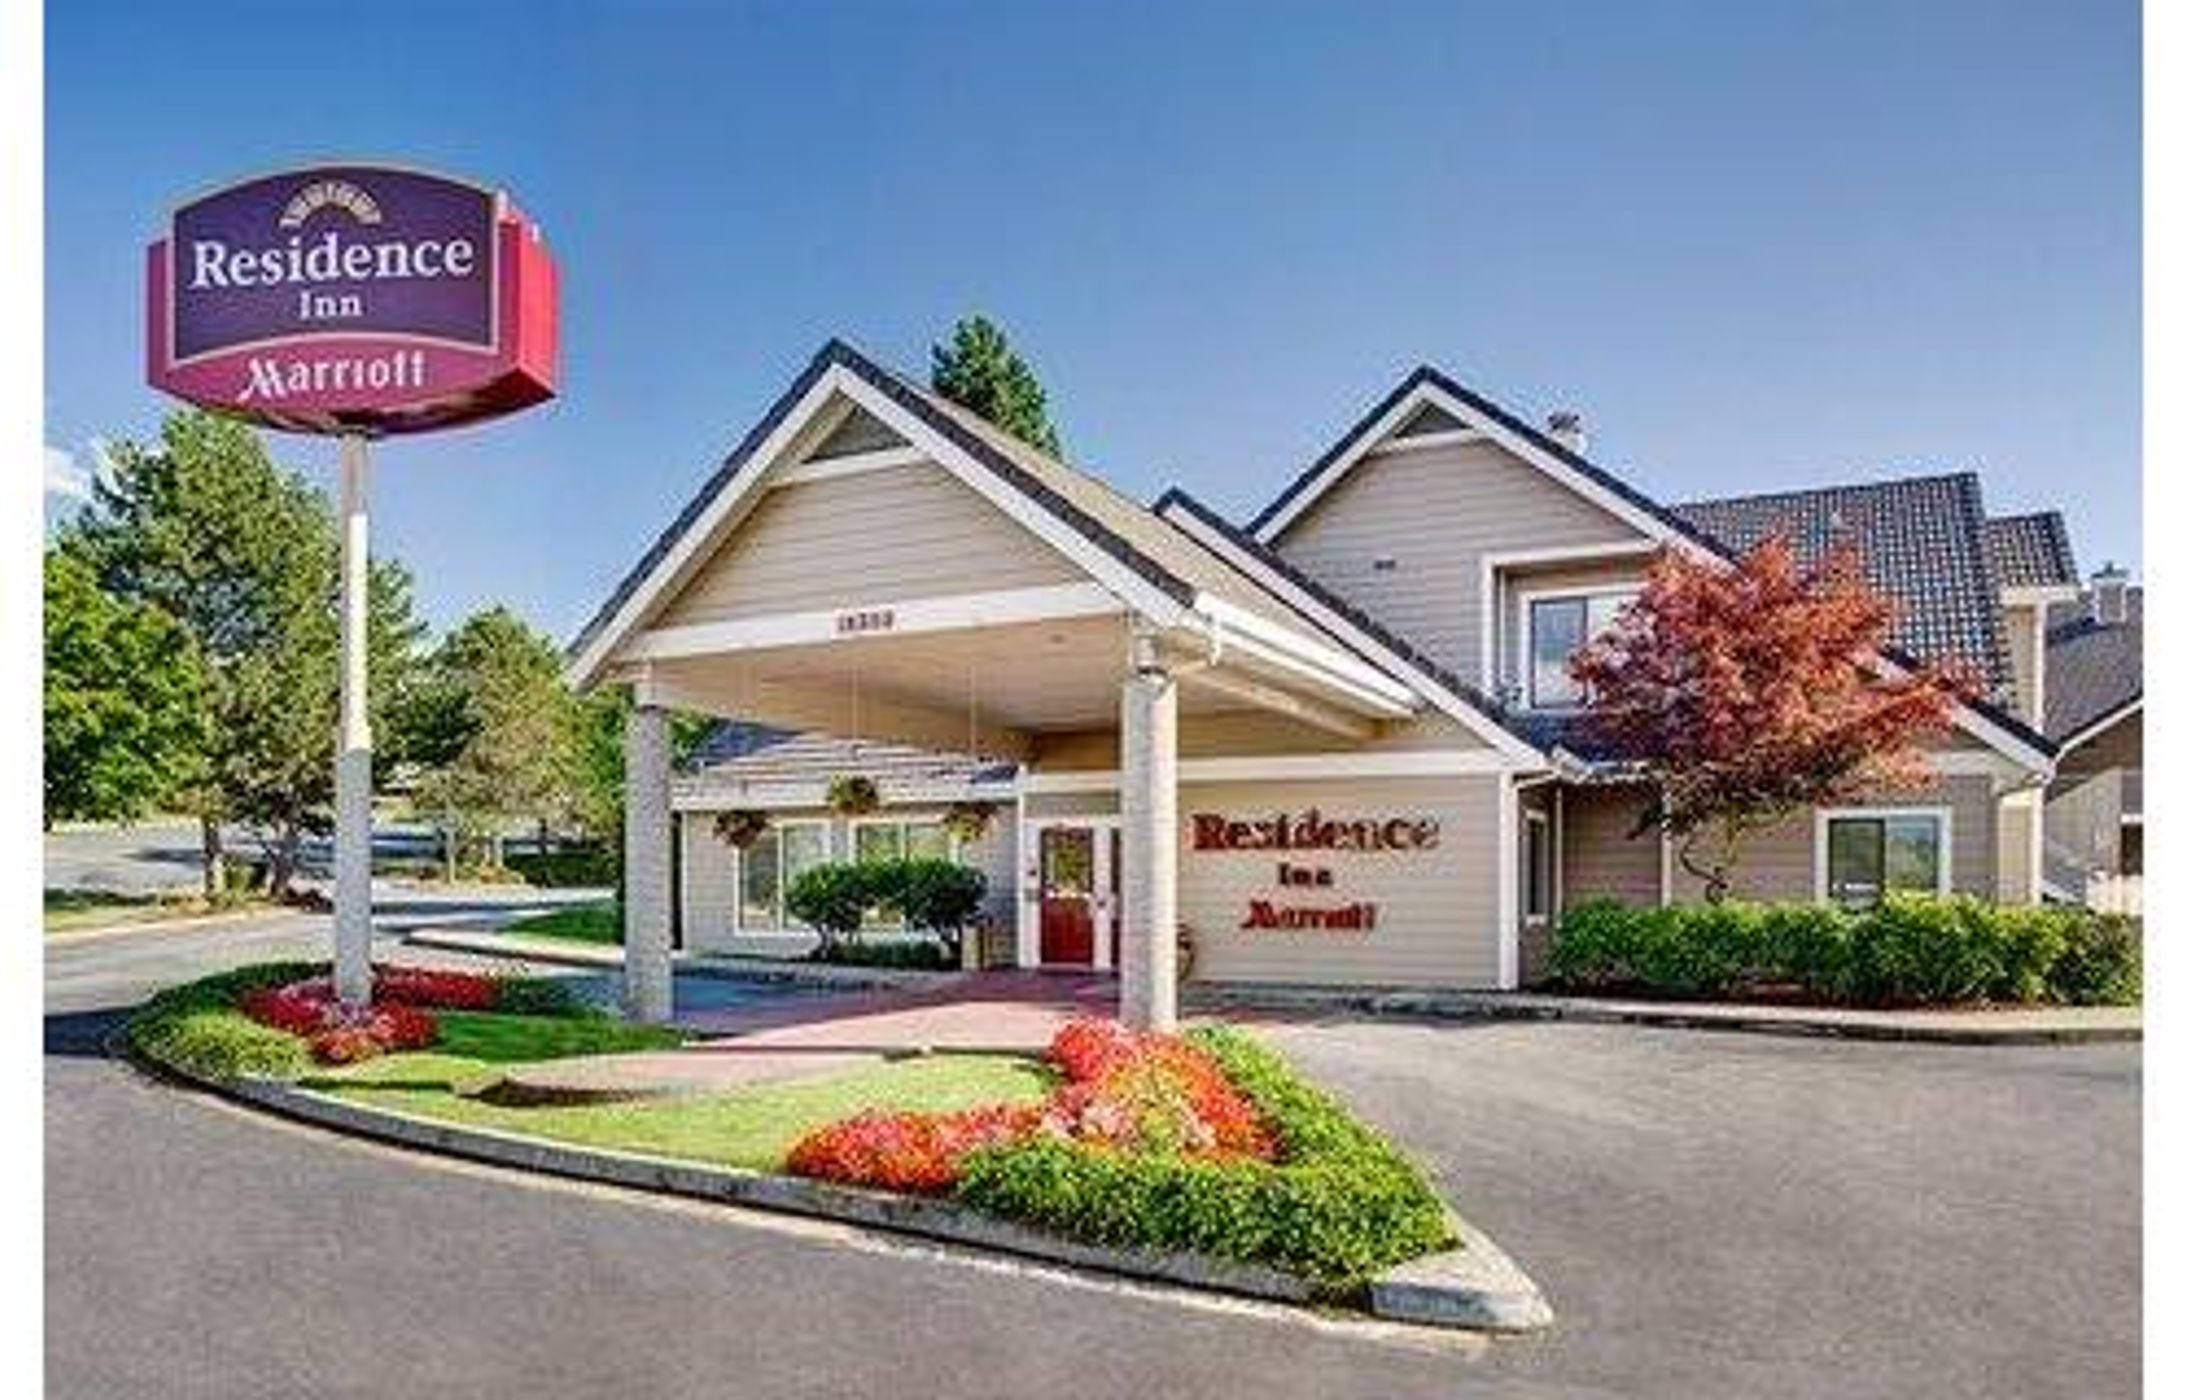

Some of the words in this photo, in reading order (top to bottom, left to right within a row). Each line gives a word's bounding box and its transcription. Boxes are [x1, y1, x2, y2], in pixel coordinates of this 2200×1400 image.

[190, 232, 474, 289] Residence
[300, 293, 364, 321] Inn
[237, 350, 426, 402] Marriott
[1192, 806, 1440, 851] Residence
